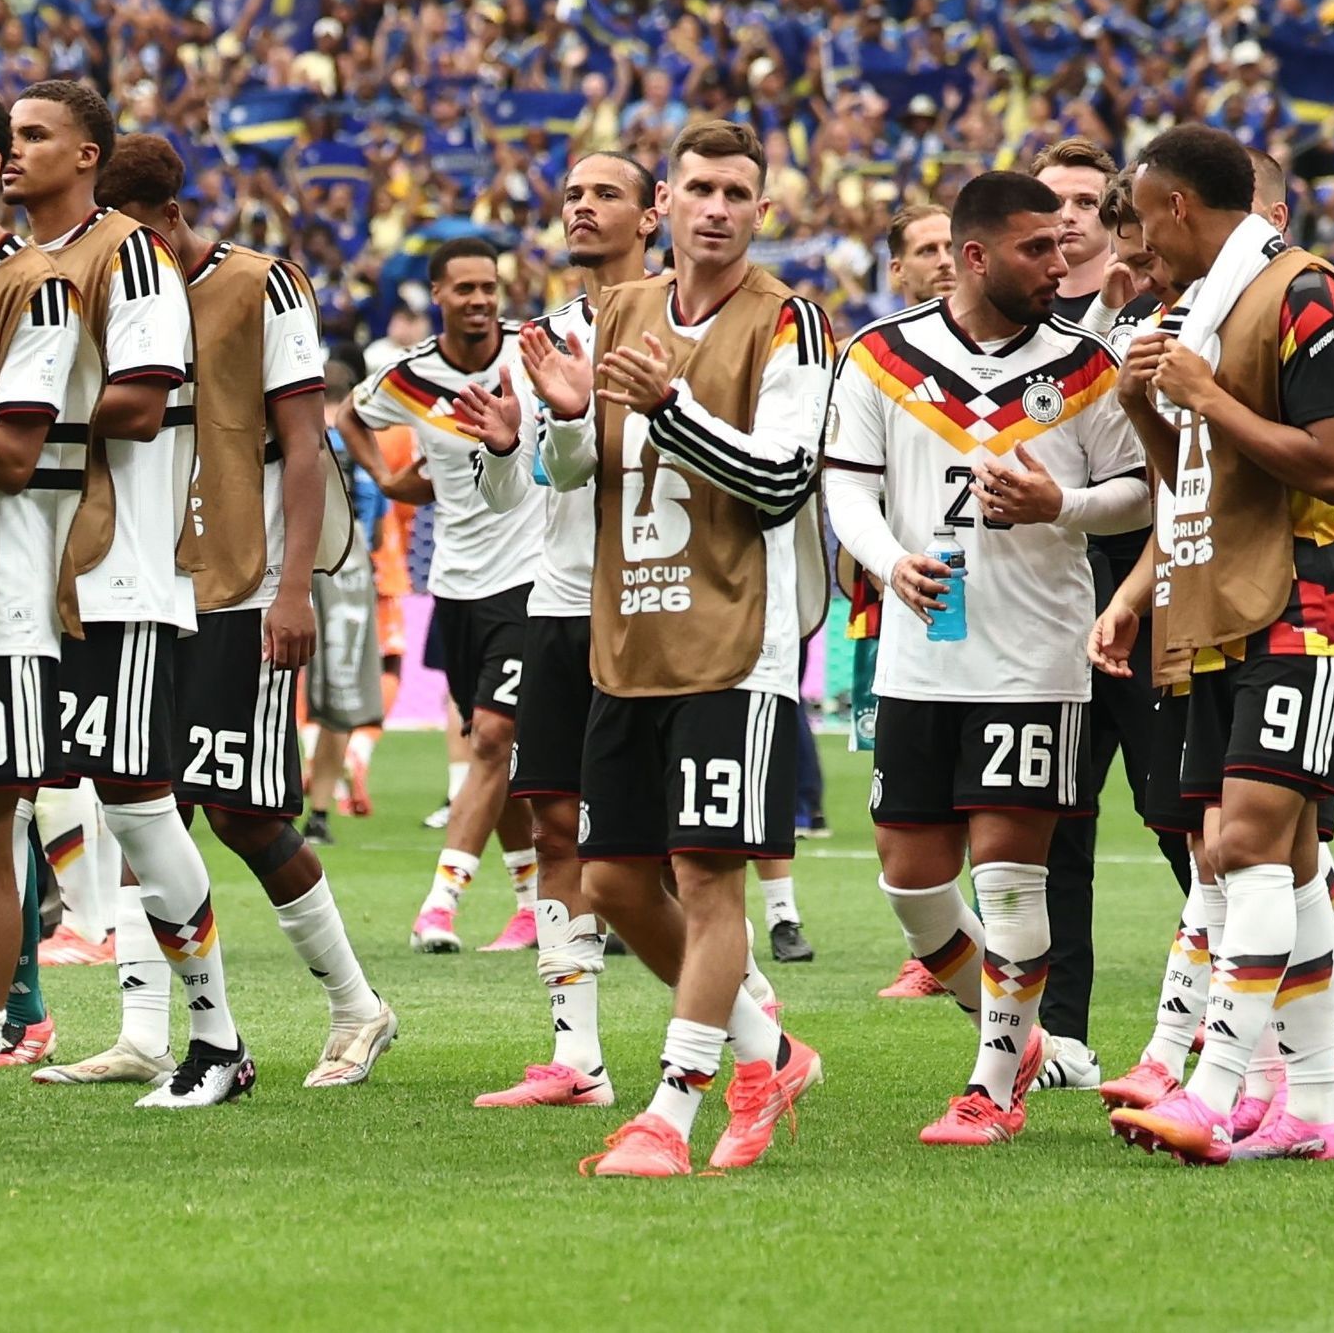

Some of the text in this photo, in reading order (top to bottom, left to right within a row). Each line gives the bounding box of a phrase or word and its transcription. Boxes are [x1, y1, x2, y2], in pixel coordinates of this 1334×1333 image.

[1173, 519, 1203, 539] ORLD
[651, 566, 692, 583] CUP
[58, 690, 110, 757] 24
[1260, 685, 1302, 752] 9
[182, 725, 247, 791] 25
[982, 723, 1053, 788] 26
[678, 758, 742, 828] 13
[182, 973, 210, 987] DFB
[1168, 969, 1193, 988] DFB
[551, 993, 566, 1007] FB
[988, 1010, 1021, 1027] DFB
